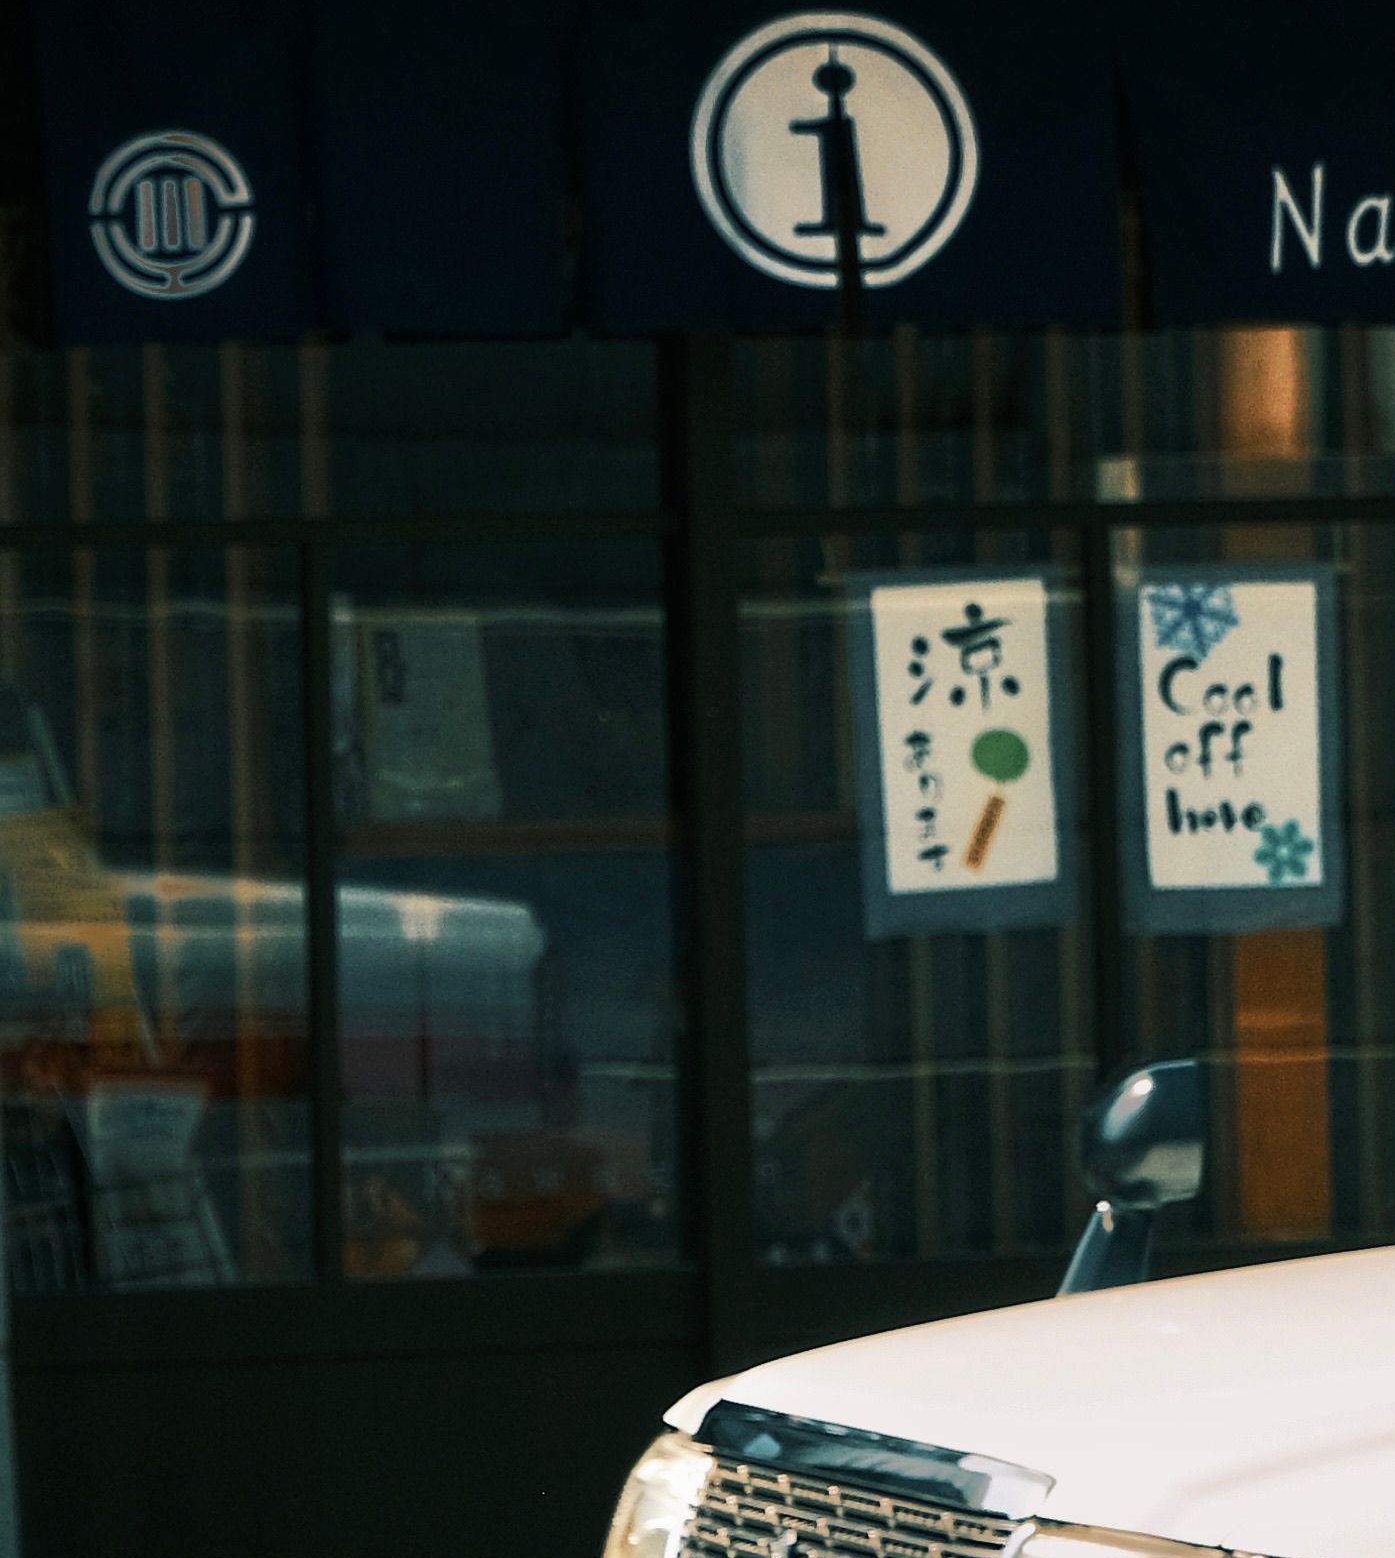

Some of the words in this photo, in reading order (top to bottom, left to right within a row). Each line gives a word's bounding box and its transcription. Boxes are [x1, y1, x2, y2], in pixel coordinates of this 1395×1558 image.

[908, 602, 1021, 714] 涼
[1157, 654, 1283, 714] Cool
[1164, 720, 1254, 779] off
